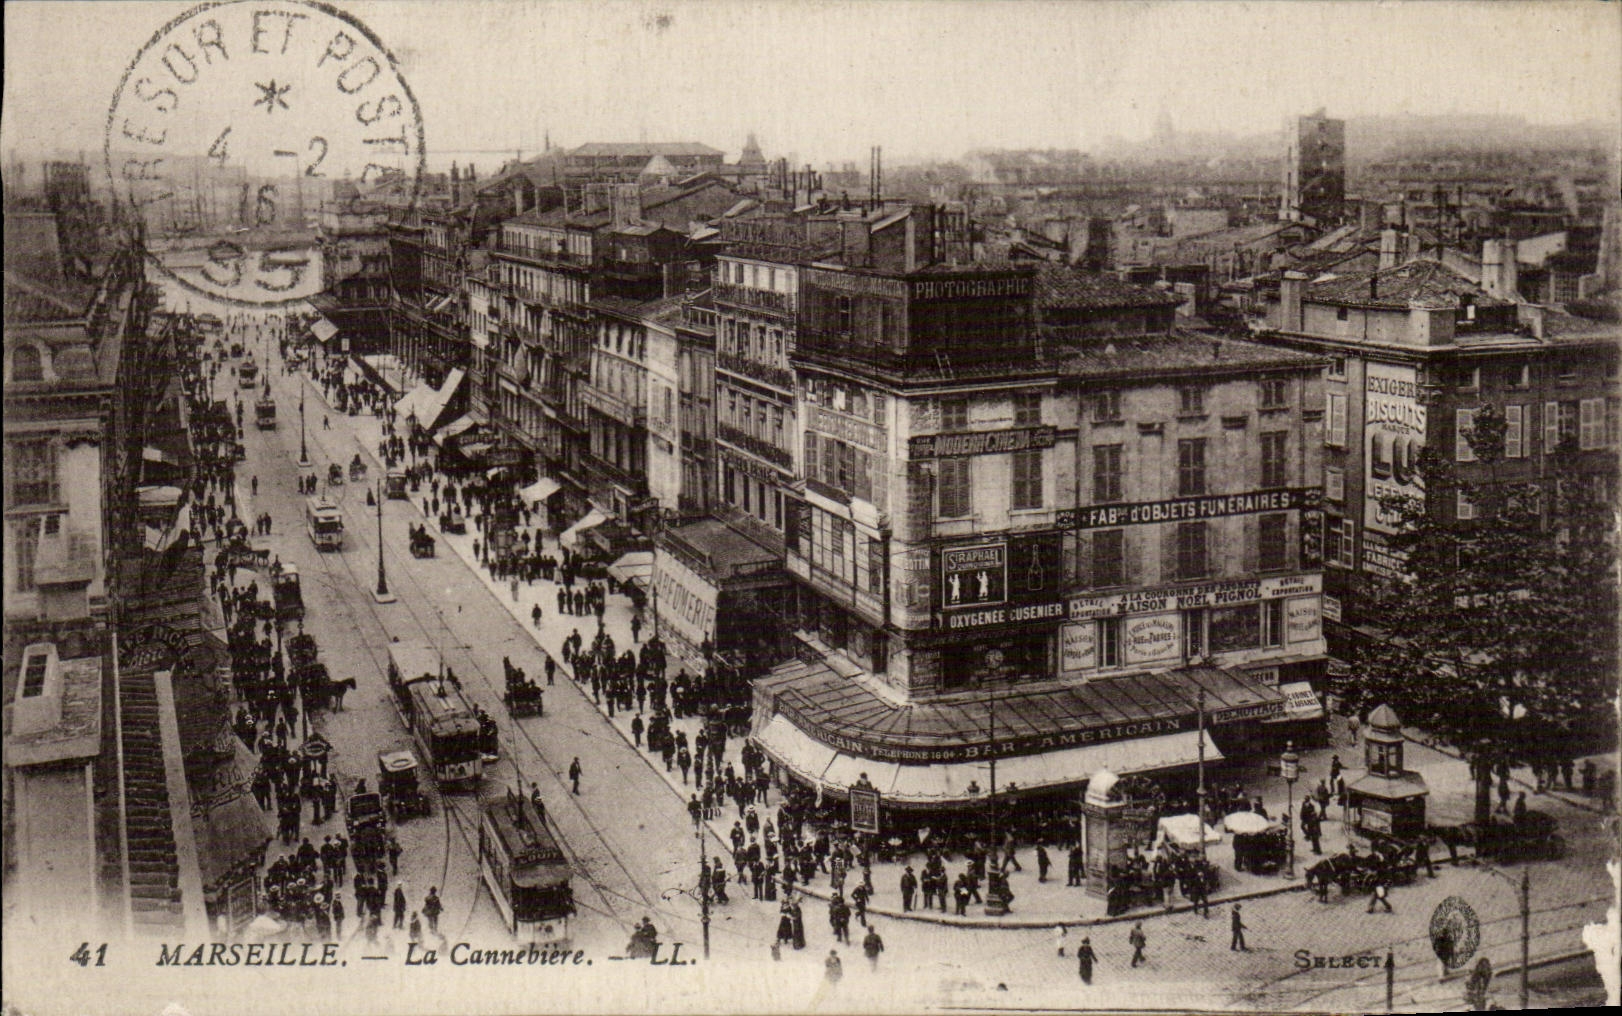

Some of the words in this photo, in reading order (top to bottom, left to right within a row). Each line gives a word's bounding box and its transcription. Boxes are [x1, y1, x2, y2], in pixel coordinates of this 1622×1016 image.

[1366, 375, 1416, 399] EXIGER
[1366, 399, 1427, 434] BISCUITS
[1371, 431, 1418, 486] LU
[1009, 602, 1063, 621] CUSENIER
[1116, 599, 1168, 615] MAISON
[1214, 587, 1263, 604] PIGNOL
[965, 741, 1015, 759] BAR
[1039, 717, 1181, 749] AMERICAIN
